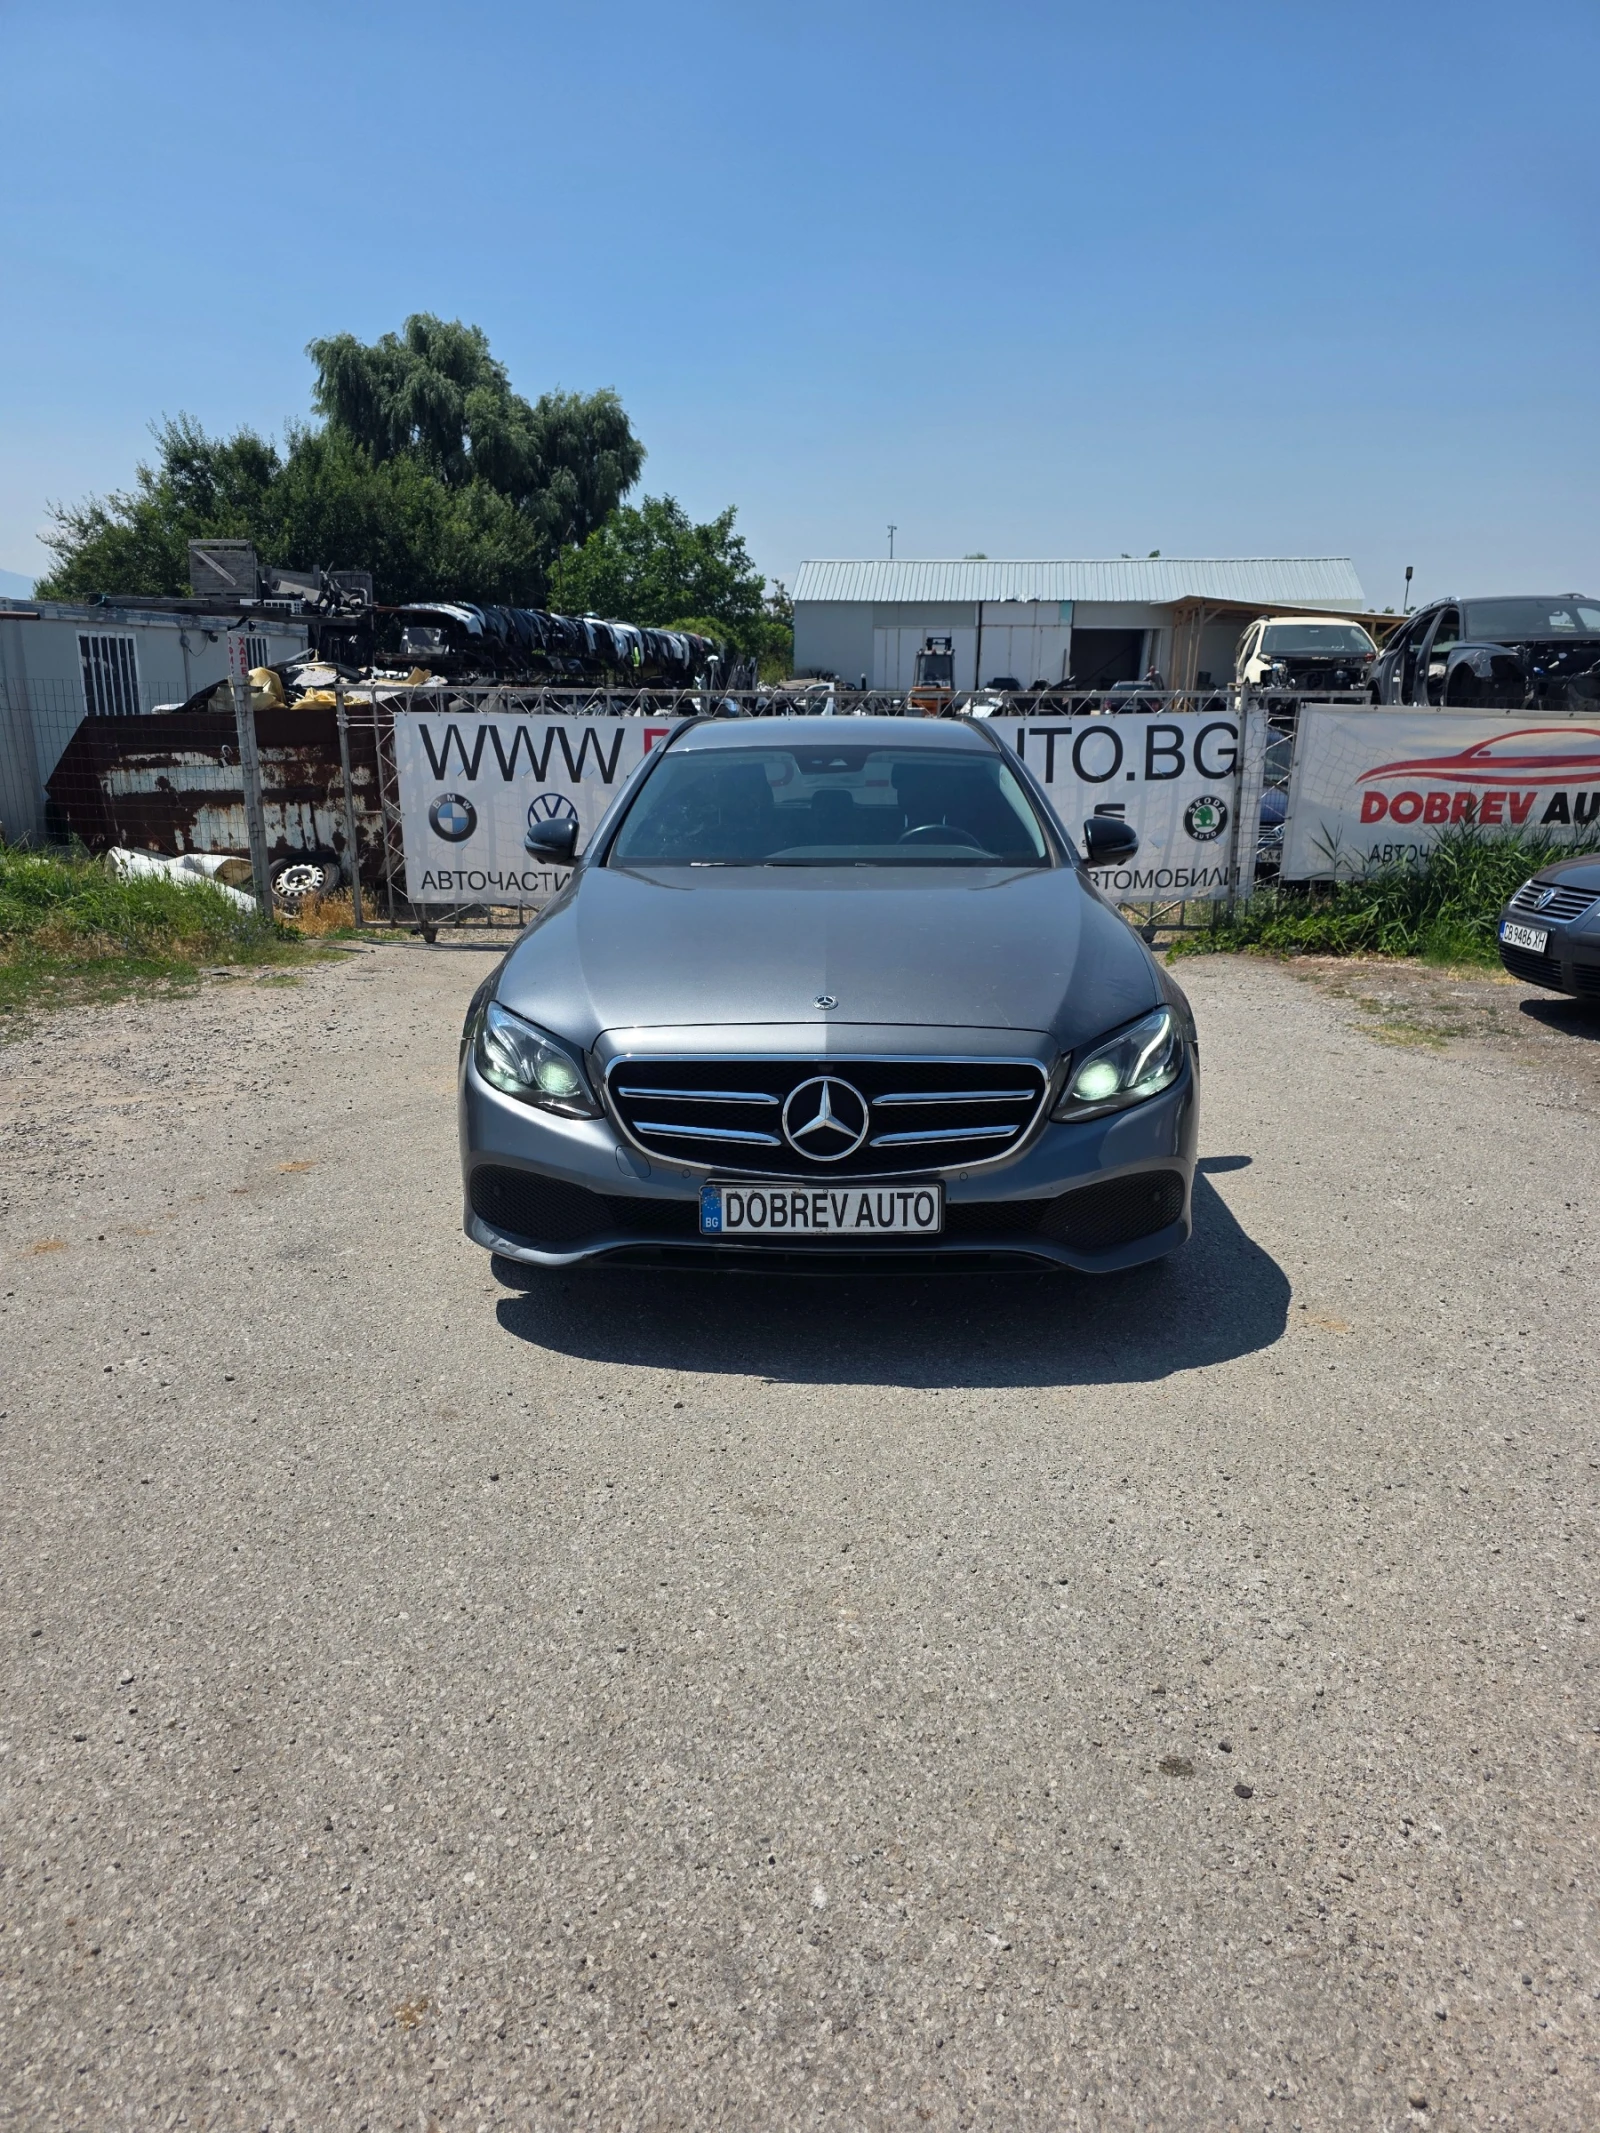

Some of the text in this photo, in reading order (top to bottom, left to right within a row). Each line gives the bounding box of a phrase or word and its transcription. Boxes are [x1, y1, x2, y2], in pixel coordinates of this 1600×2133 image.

[432, 795, 472, 810] BMW
[1188, 797, 1226, 814] SKODA
[1360, 791, 1538, 824] DOBREV
[1192, 831, 1217, 840] AUTO
[705, 1217, 719, 1229] BG
